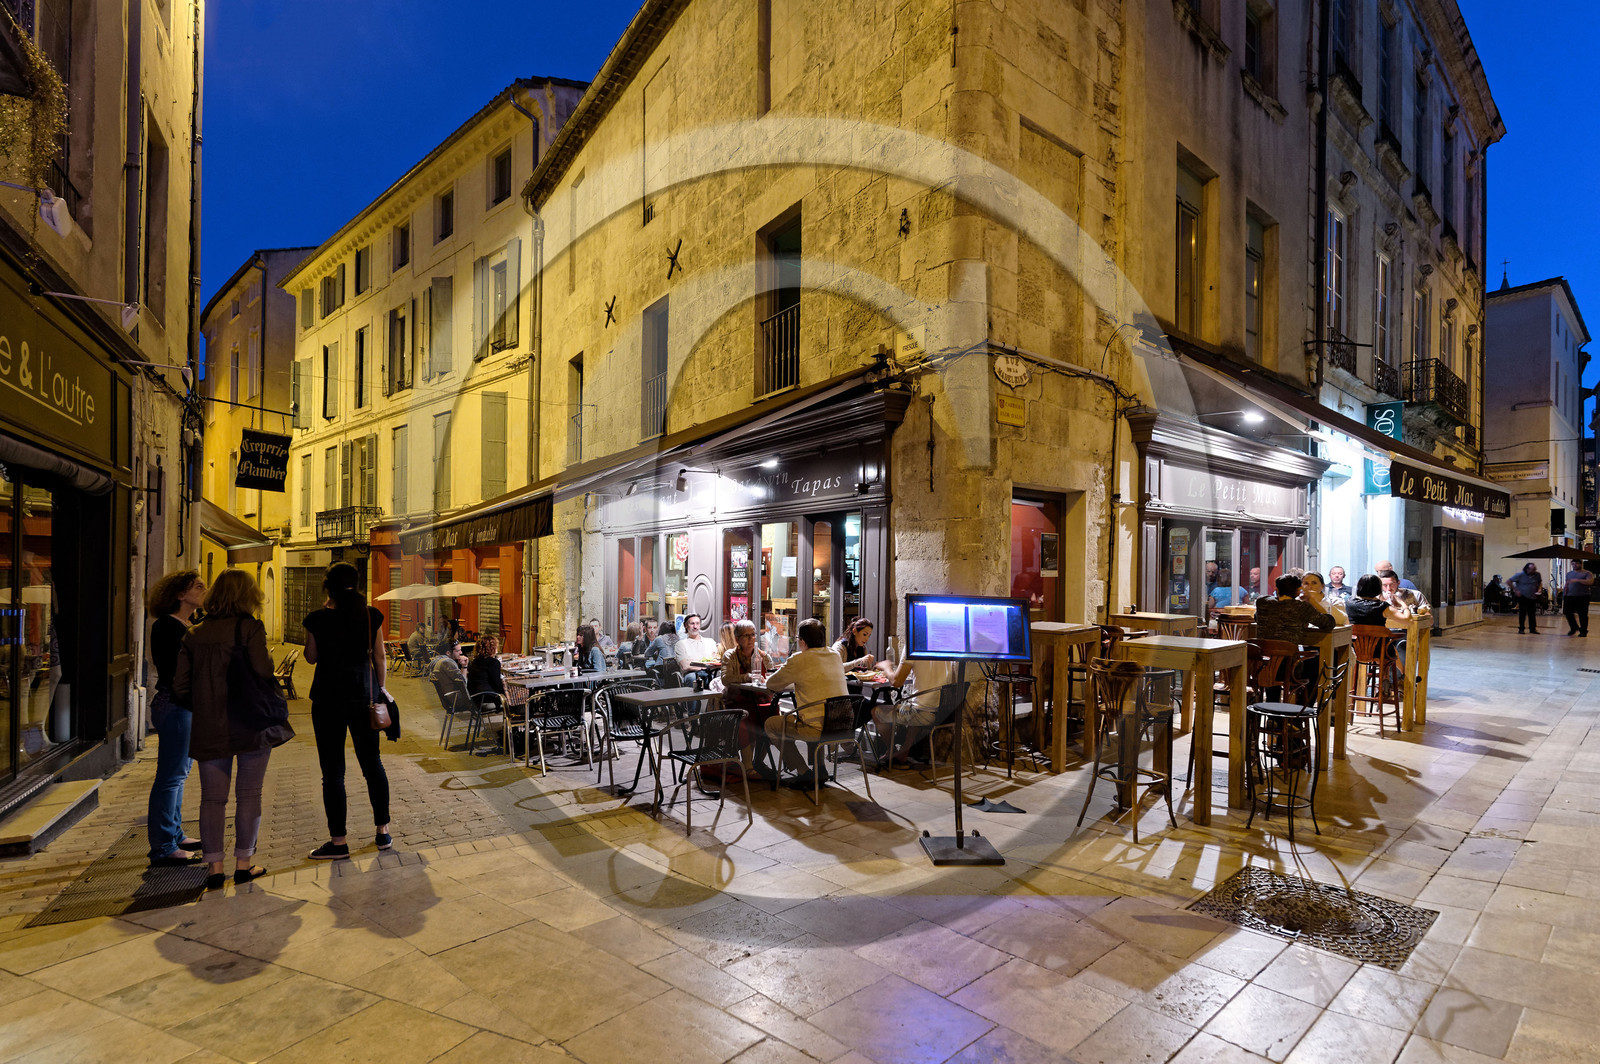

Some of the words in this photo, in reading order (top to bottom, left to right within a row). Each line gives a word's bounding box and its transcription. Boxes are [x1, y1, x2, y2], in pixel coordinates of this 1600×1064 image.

[902, 341, 918, 352] FRESQUE
[1005, 356, 1020, 367] RUE
[19, 341, 33, 390] &
[40, 351, 95, 424] L'autre
[997, 367, 1028, 384] MADELEINE
[259, 454, 269, 465] la
[239, 460, 286, 480] Flambée
[791, 476, 842, 497] Tapas
[1187, 475, 1206, 498] Le
[1214, 478, 1247, 502] Petit
[1252, 484, 1278, 505] Mas
[1399, 470, 1414, 496] Le
[1422, 476, 1448, 503] Petit
[1454, 484, 1474, 507] Mas
